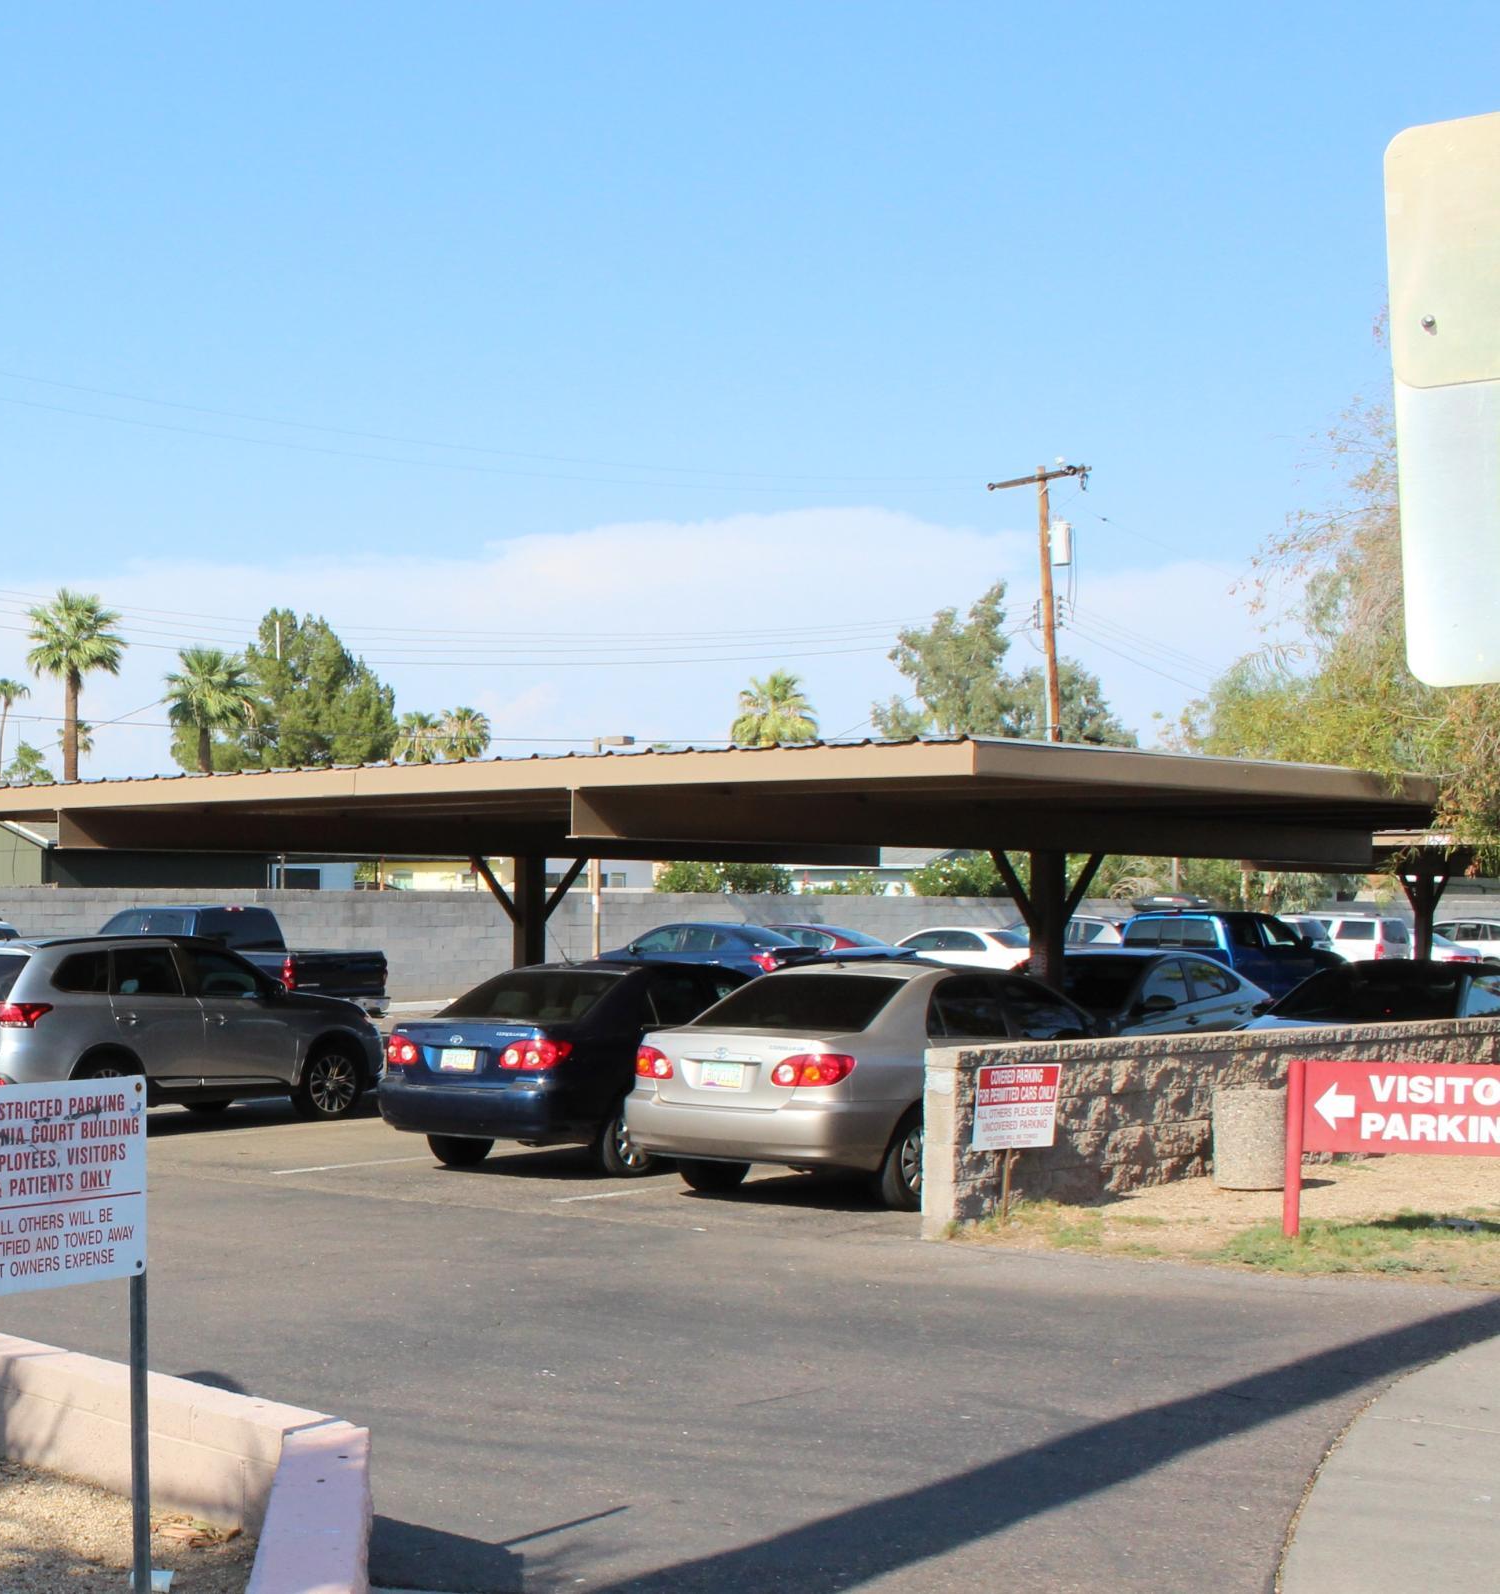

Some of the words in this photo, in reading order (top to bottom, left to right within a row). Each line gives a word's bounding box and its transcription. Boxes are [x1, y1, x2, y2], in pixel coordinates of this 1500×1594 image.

[990, 1070, 1016, 1086] COVERED
[1016, 1068, 1044, 1083] PARKING
[69, 1094, 124, 1116] PARKING
[980, 1089, 989, 1103] FOR
[990, 1086, 1019, 1102] PERMITTED
[1021, 1085, 1037, 1100] CARS
[1039, 1085, 1056, 1100] ONLY
[989, 1108, 1012, 1118] OTHERS
[1014, 1106, 1038, 1116] PLEASE
[1041, 1106, 1053, 1116] USE
[32, 1122, 74, 1144] COURT
[81, 1118, 139, 1139] BUILDING
[1020, 1119, 1048, 1129] PARKING
[67, 1144, 126, 1164] VISITORS
[10, 1174, 73, 1196] PATIENTS
[81, 1170, 112, 1190] ONLY
[19, 1214, 64, 1232] OTHERS
[69, 1210, 94, 1226] WILL
[99, 1208, 113, 1222] BE
[36, 1236, 59, 1252] AND
[64, 1229, 102, 1248] TOWED
[107, 1225, 135, 1242] AWAY
[10, 1256, 60, 1277] OWNERS
[65, 1249, 115, 1269] EXPENSE
